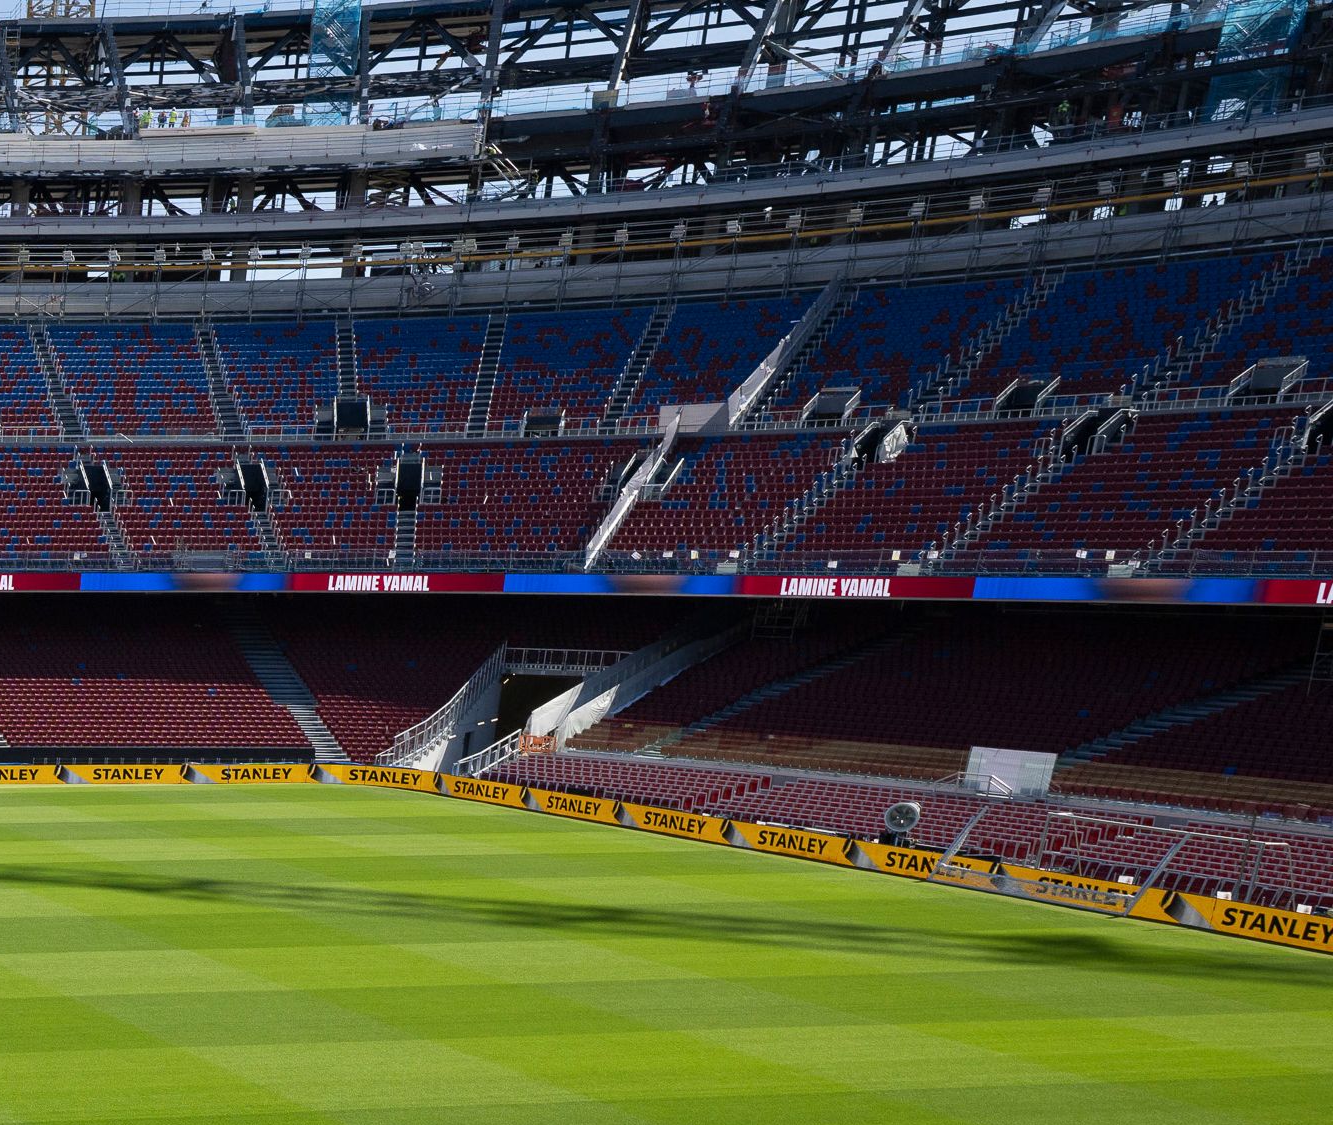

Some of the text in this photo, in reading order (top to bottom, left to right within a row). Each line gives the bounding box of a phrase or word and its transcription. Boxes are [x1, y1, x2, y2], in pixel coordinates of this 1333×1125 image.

[328, 576, 429, 591] LAMINE YAMAL
[781, 578, 891, 596] LAMINE YAMAL
[93, 769, 164, 779] STANLEY
[221, 768, 291, 780] STANLEY
[349, 768, 420, 786] STANLEY
[454, 781, 510, 801] STANLEY
[546, 796, 601, 816] STANLEY
[643, 811, 707, 835] STANLEY
[758, 831, 829, 856] STANLEY
[1221, 907, 1333, 944] STANLEY
